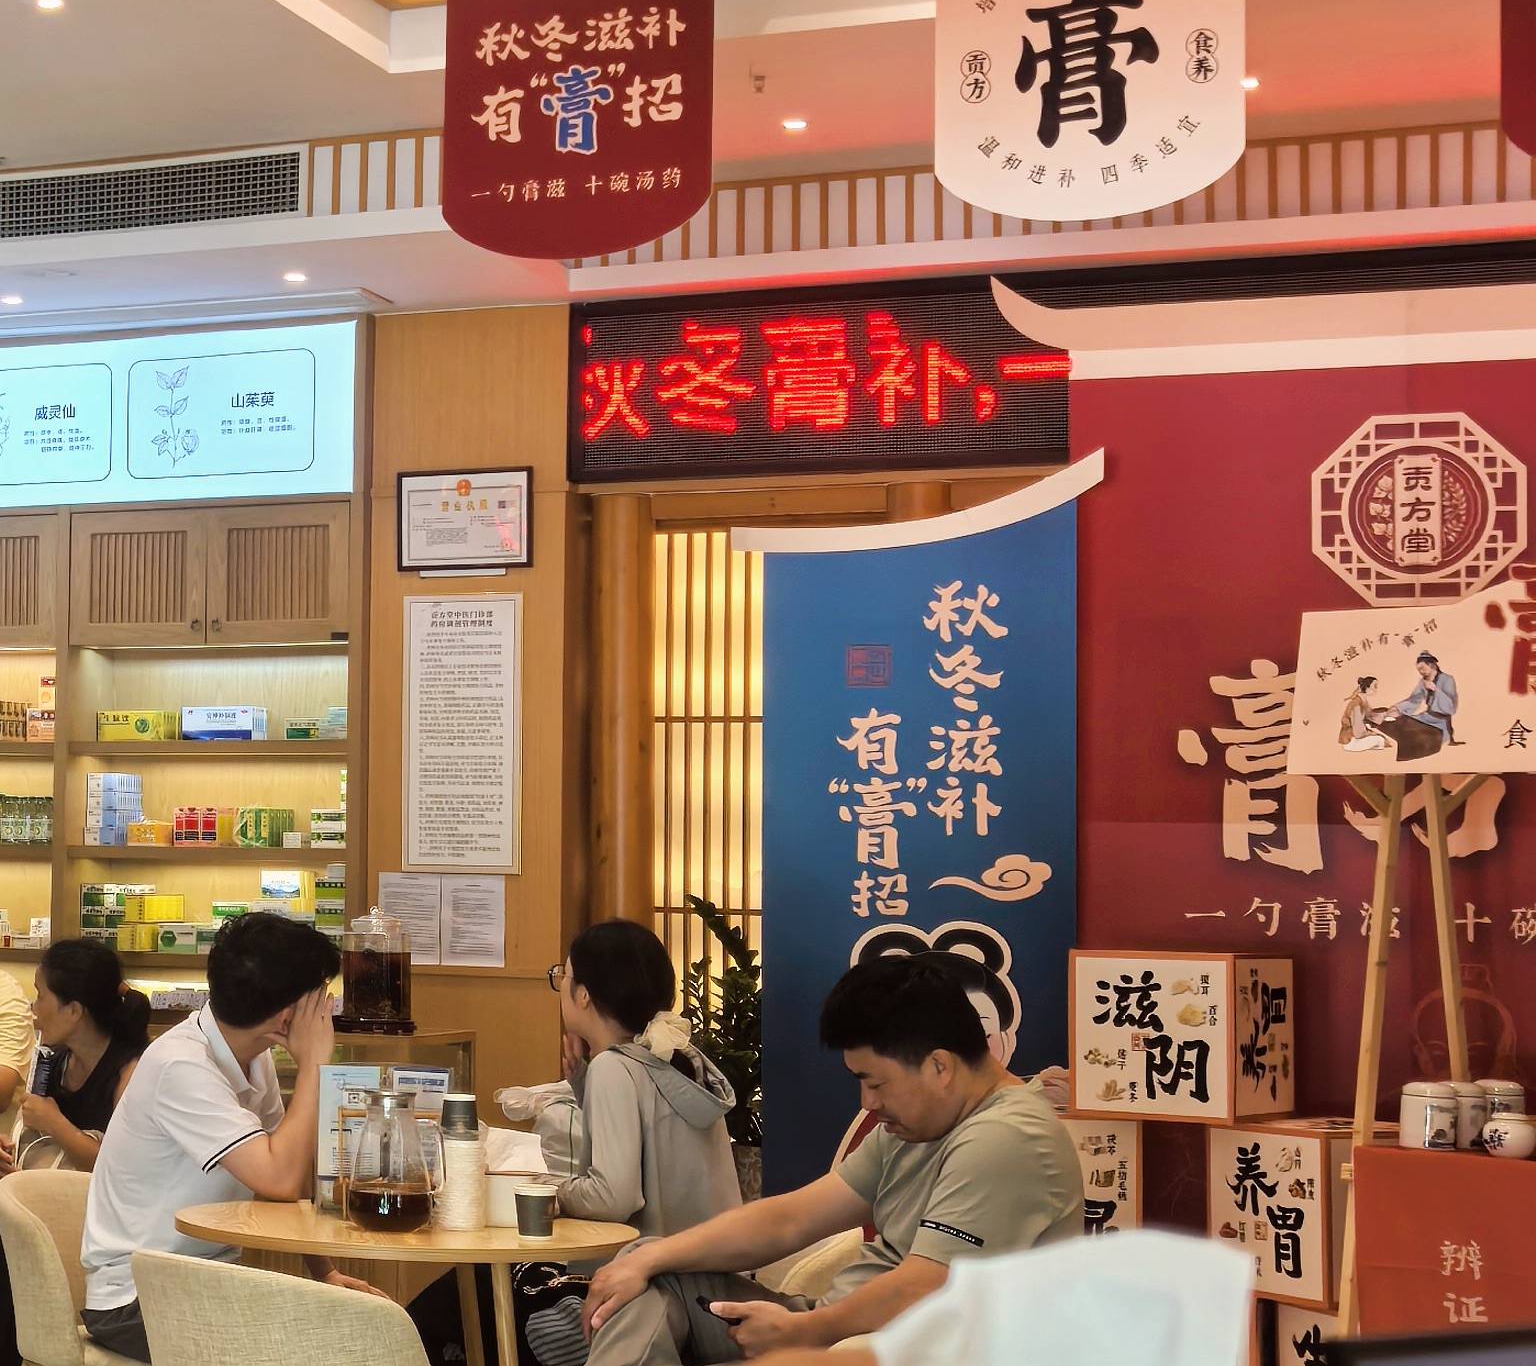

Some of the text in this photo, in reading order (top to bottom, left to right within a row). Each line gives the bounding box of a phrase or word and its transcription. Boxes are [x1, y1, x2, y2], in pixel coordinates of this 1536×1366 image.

[475, 7, 686, 66] 秋冬滋补
[1190, 30, 1215, 81] 食养
[471, 63, 683, 155] 有“膏”招
[964, 53, 987, 100] 贡方
[471, 167, 681, 202] 一勺膏滋 十碗汤药
[977, 115, 1200, 188] 温和进补 四季适宜
[34, 403, 77, 421] 威灵仙
[231, 391, 275, 409] 山茱萸
[1400, 467, 1436, 553] 贡方堂
[922, 580, 1008, 836] 秋冬滋补
[828, 708, 927, 918] 有“膏”招
[1092, 970, 1210, 1103] 滋阴
[1225, 1142, 1305, 1279] 养胃
[1439, 1239, 1488, 1324] 辨证
